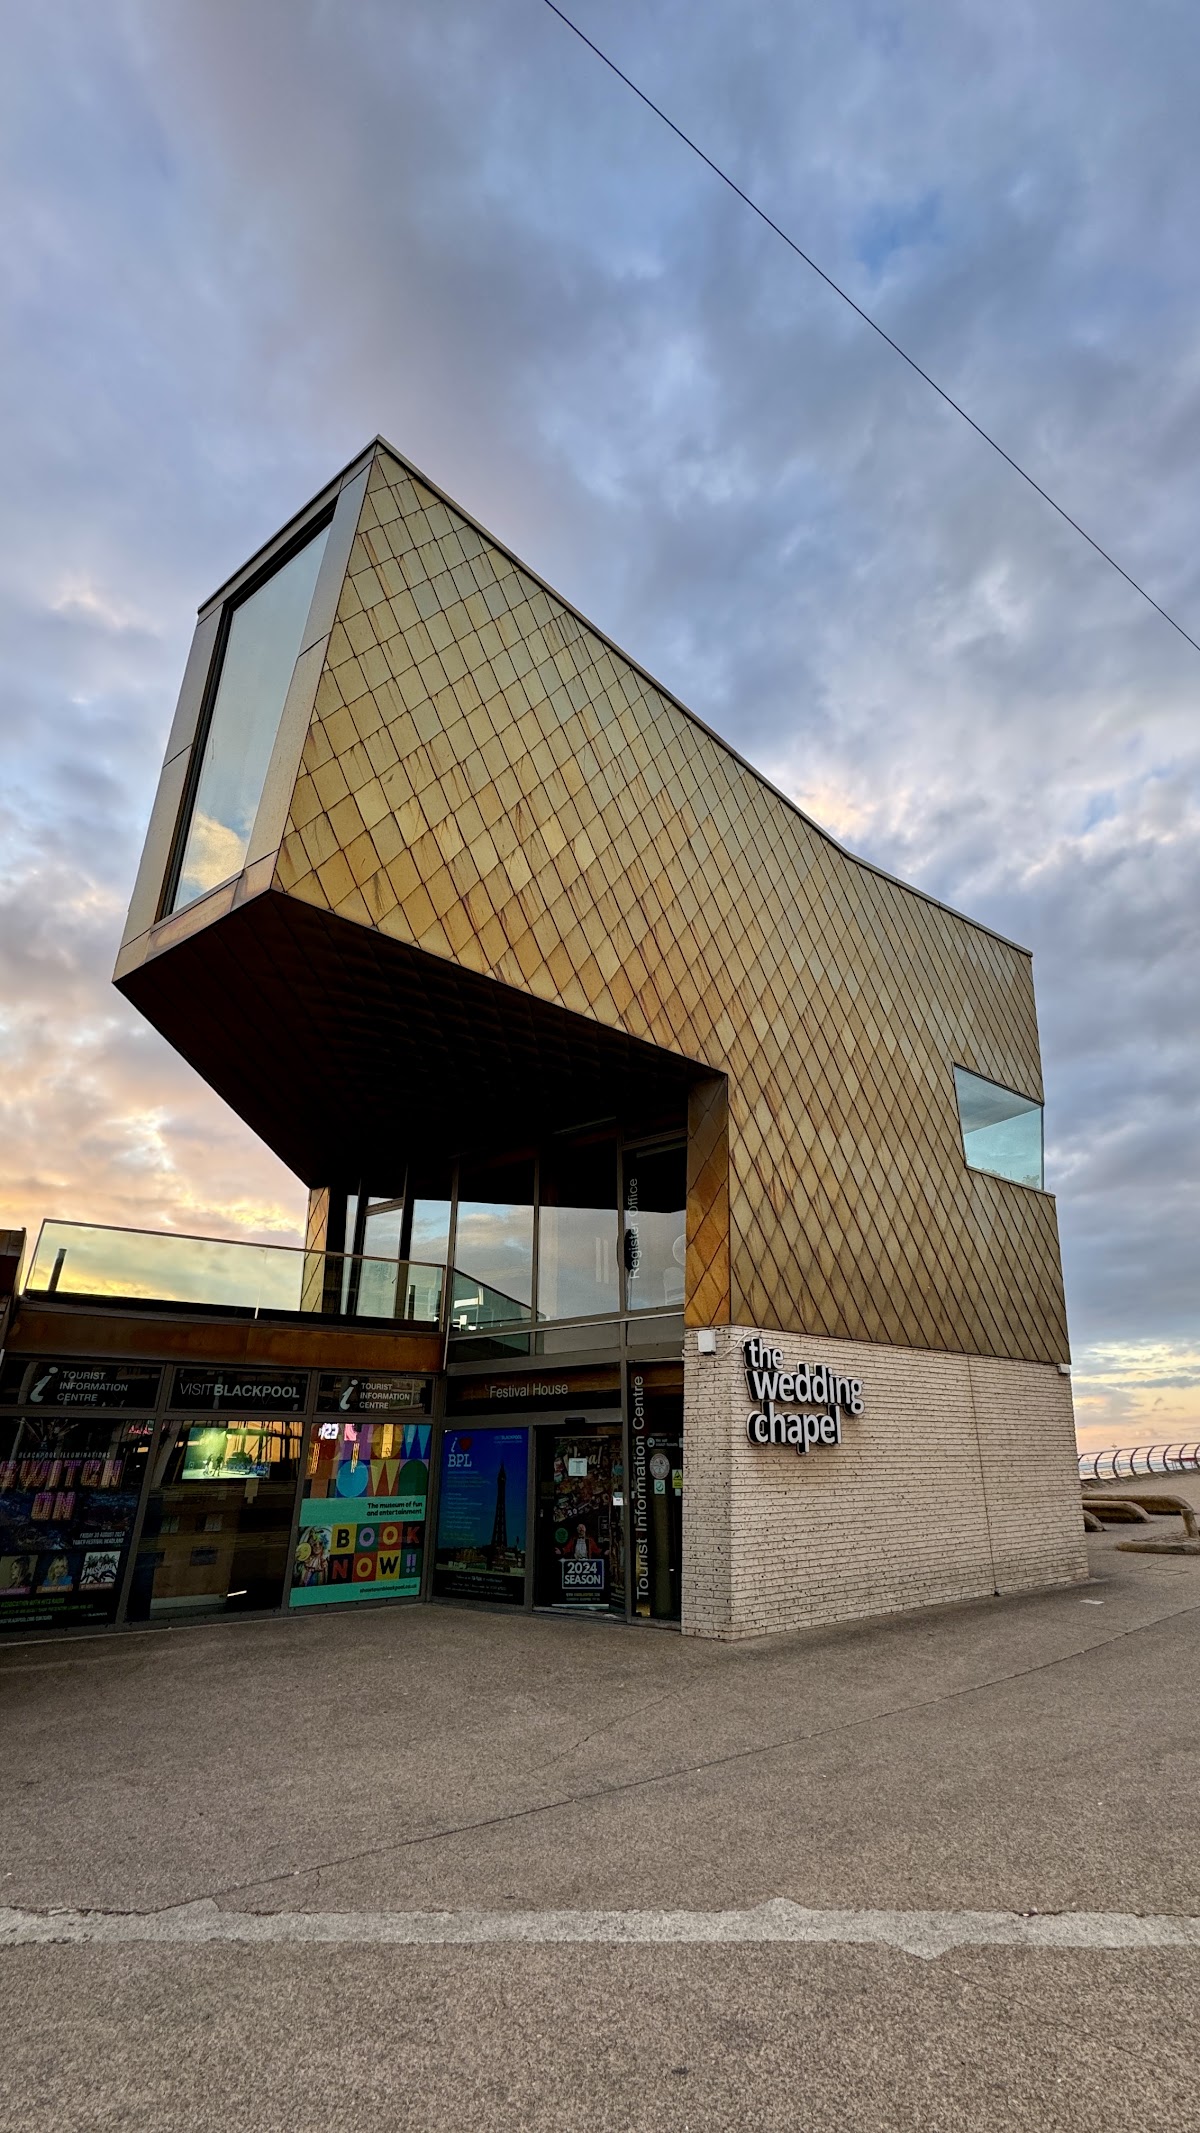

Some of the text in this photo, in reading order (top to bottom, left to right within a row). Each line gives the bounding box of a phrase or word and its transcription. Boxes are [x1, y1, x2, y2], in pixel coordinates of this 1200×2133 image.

[627, 1178, 641, 1279] Register Office
[748, 1338, 784, 1369] the
[62, 1370, 107, 1380] TOURIST
[59, 1381, 129, 1392] INFORMATION
[361, 1382, 393, 1391] TOURIST
[489, 1382, 569, 1398] Festival House
[751, 1363, 865, 1414] wedding
[56, 1393, 98, 1402] CENTRE
[359, 1391, 410, 1401] INFORMATION
[359, 1401, 389, 1409] CENTRE
[754, 1401, 841, 1453] chapel
[447, 1453, 473, 1468] BPL
[632, 1375, 649, 1599] Tourist Information Centre
[31, 1491, 77, 1521] ON
[366, 1508, 422, 1517] and entertainment
[336, 1525, 420, 1548] BOOK
[566, 1561, 598, 1575] 2024
[564, 1574, 601, 1585] SEASON
